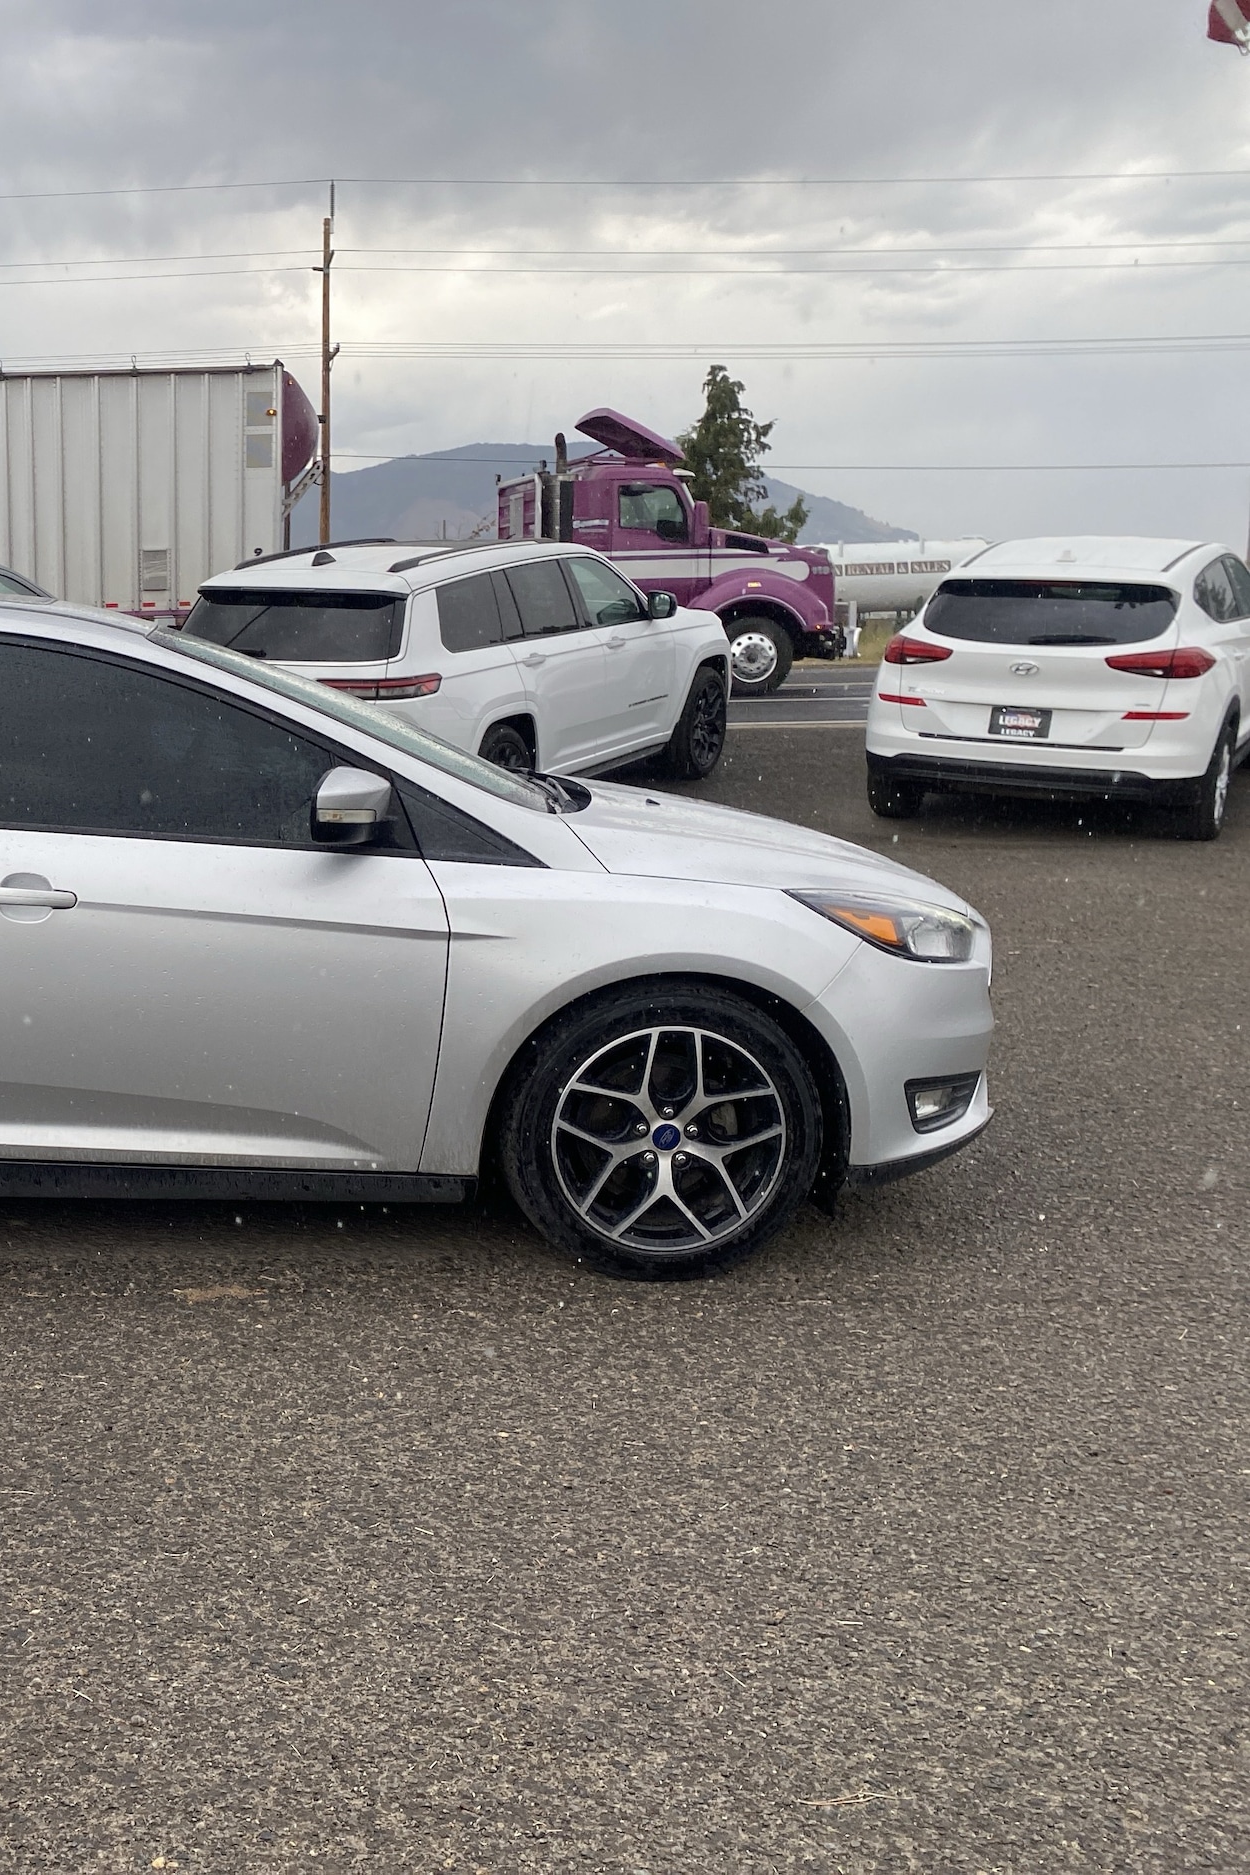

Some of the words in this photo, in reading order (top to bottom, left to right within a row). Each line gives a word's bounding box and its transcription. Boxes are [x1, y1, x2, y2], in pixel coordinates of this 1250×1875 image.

[847, 563, 893, 575] RENTAL
[913, 562, 949, 573] SALES
[999, 715, 1041, 728] LEGACY
[1001, 728, 1035, 737] LEGACY
